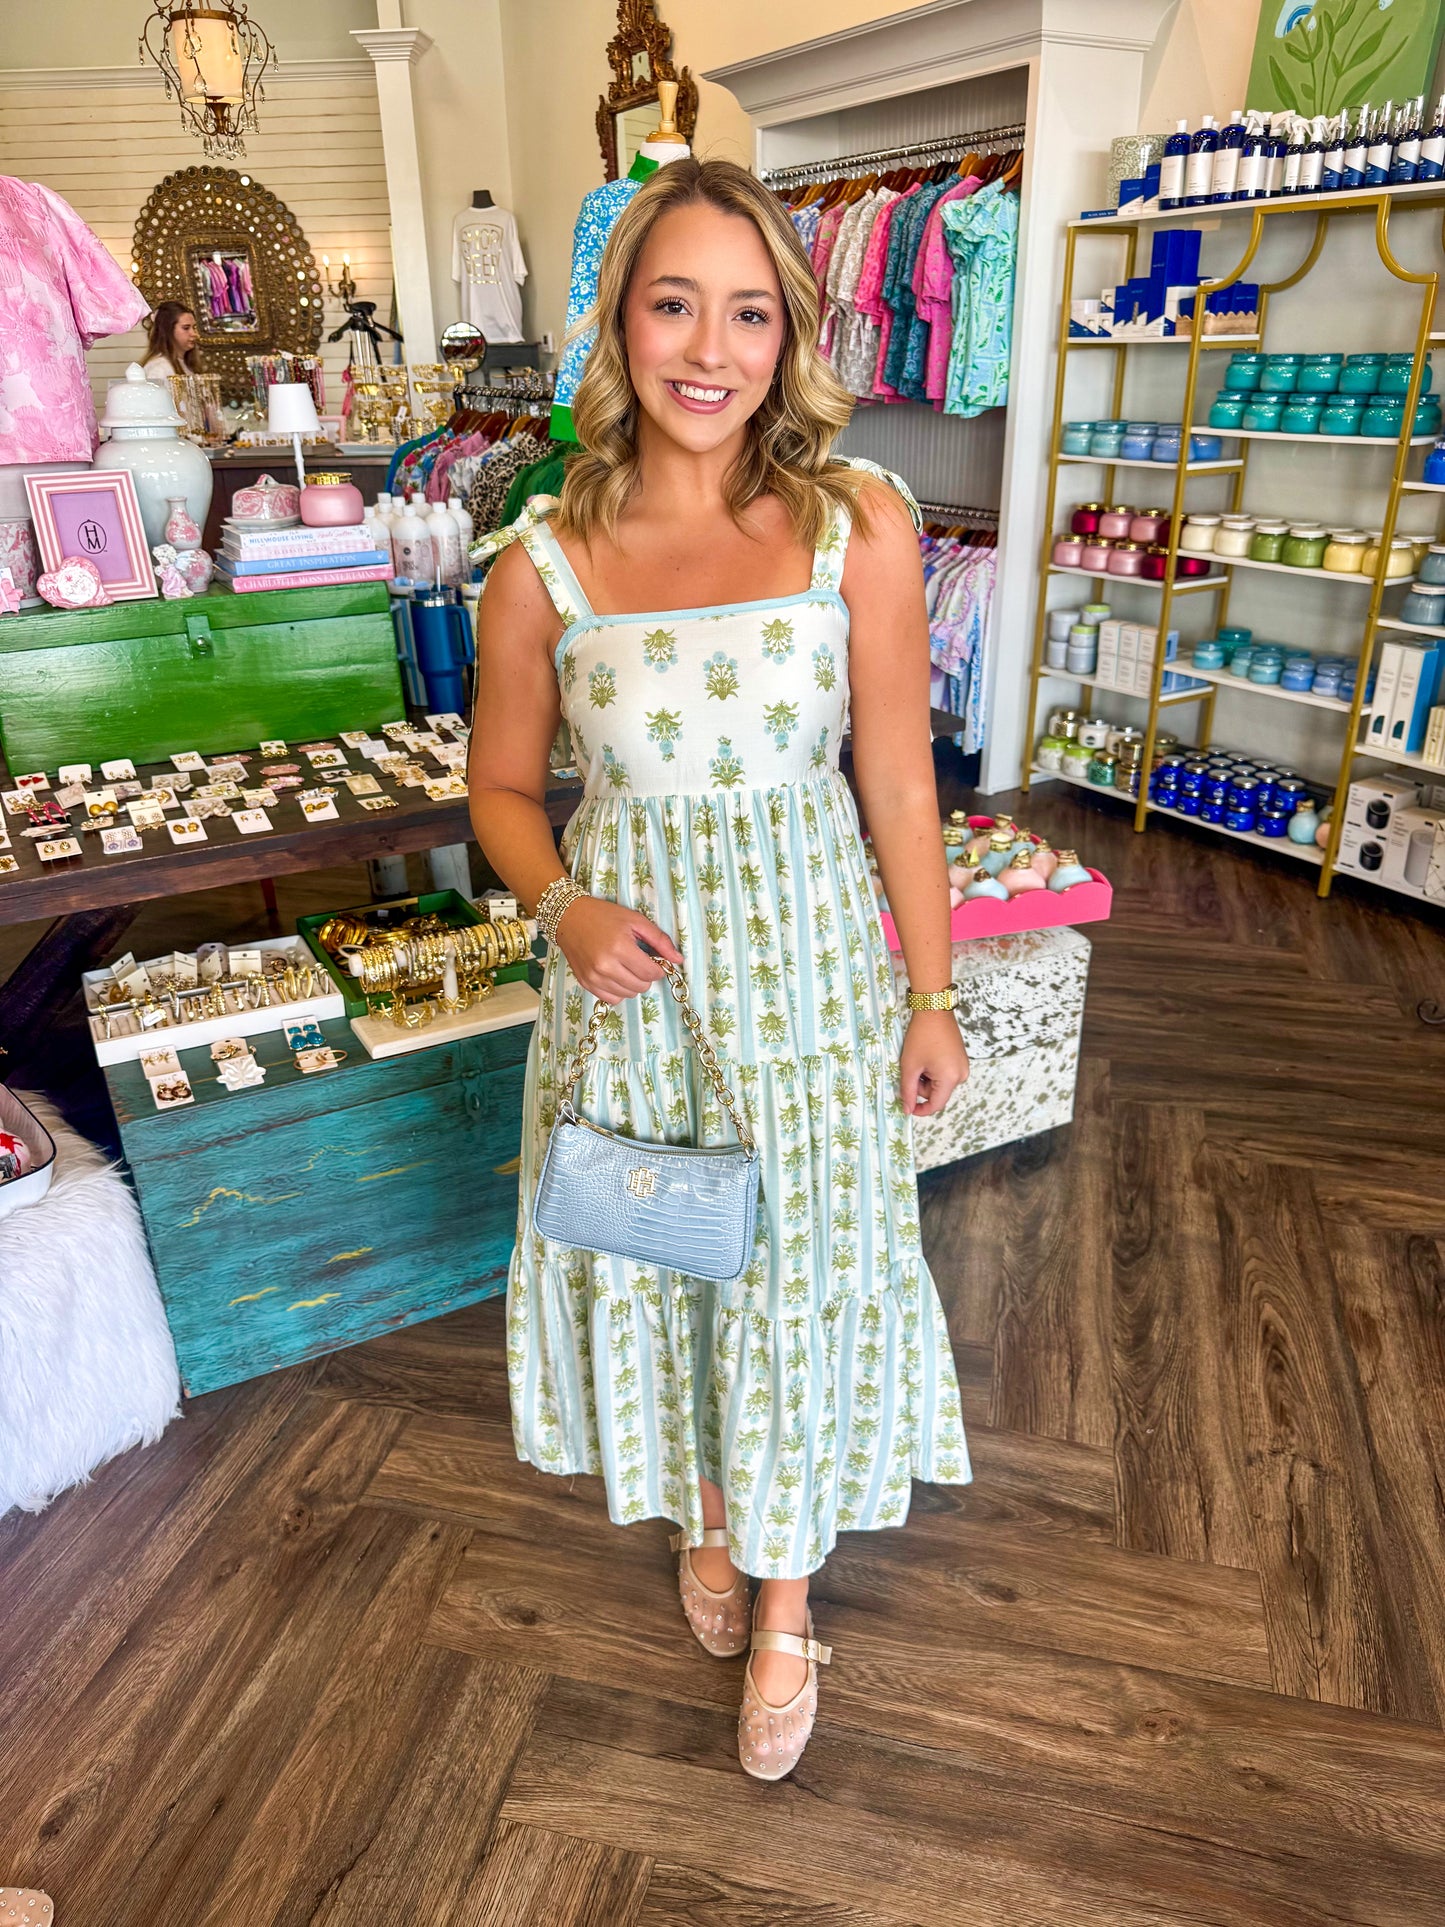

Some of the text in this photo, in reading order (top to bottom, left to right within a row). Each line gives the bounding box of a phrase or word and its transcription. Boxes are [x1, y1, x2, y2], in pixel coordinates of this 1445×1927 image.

[266, 534, 288, 542] HOUSE
[267, 555, 356, 569] GREAT INSPIRATION
[244, 571, 376, 589] CHARLOTTE MOSS ENTERTAINS
